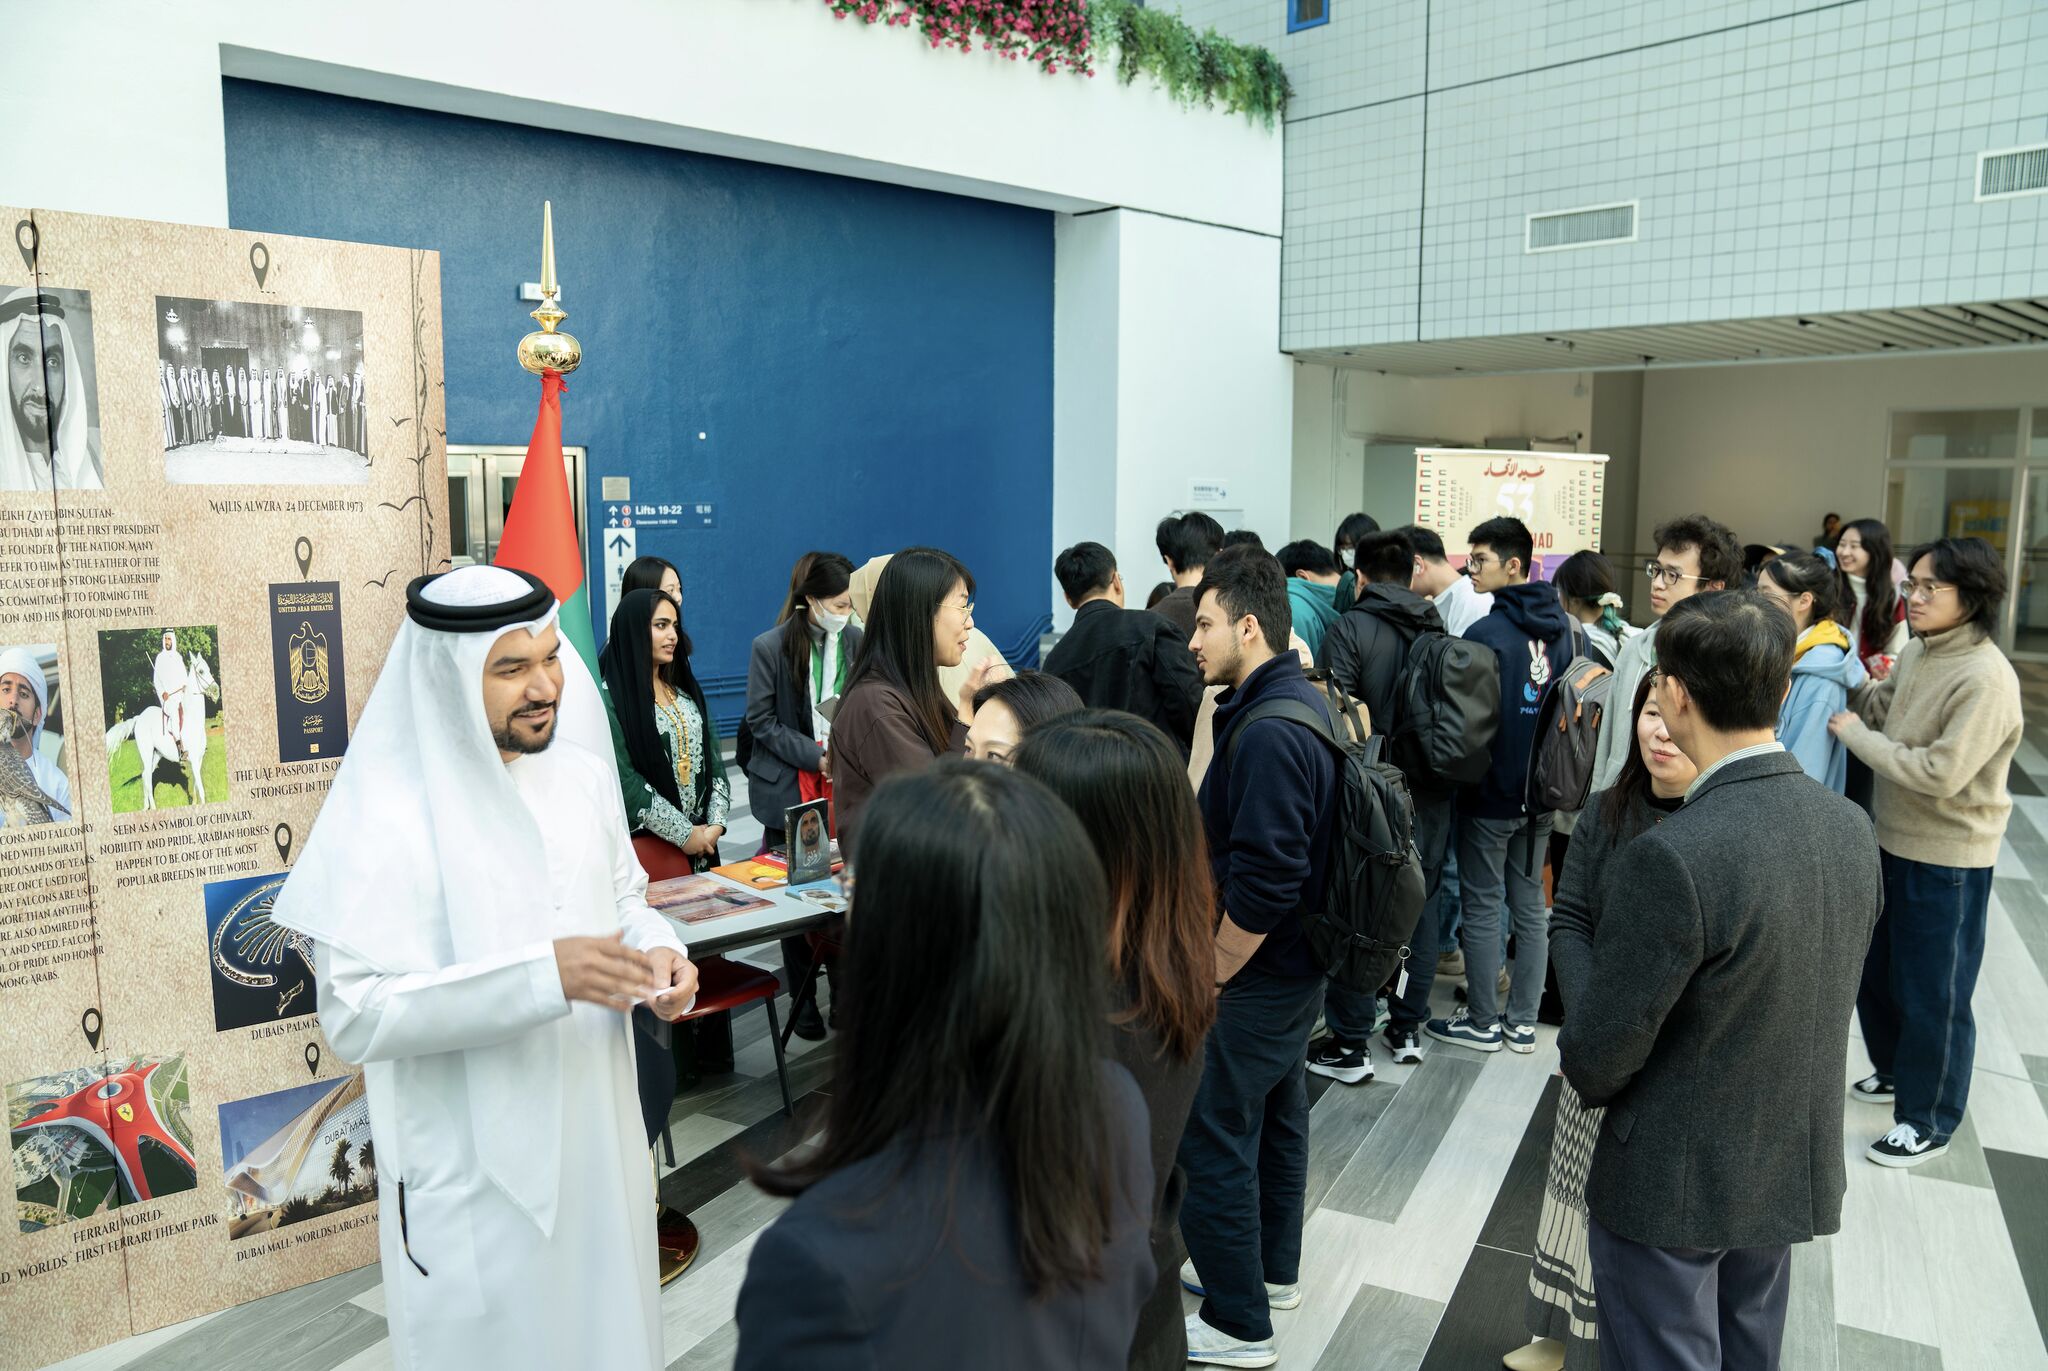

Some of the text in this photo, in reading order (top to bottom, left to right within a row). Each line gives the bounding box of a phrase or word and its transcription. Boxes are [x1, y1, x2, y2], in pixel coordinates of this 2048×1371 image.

[27, 510, 56, 523] ZAYED
[58, 509, 74, 518] BIN
[208, 500, 364, 514] MAJLIS ALWZRA 24 DECEMBER 1973
[635, 505, 682, 514] Lifts 19-22
[13, 528, 43, 537] DHABI
[46, 526, 65, 536] AND
[67, 525, 85, 536] THE
[87, 525, 110, 534] FIRST
[113, 524, 160, 534] PRESIDENT
[8, 544, 54, 555] FOUNDER
[56, 544, 68, 554] OF
[70, 542, 88, 553] THE
[90, 542, 127, 552] NATION.
[128, 540, 154, 553] MANY
[24, 562, 38, 572] TO
[40, 561, 58, 571] HIM
[60, 560, 71, 570] AS
[94, 558, 127, 568] FATHER
[130, 558, 142, 568] OF
[144, 558, 160, 567] THE
[38, 578, 50, 588] OF
[52, 576, 67, 588] HIS
[69, 575, 106, 586] STRONG
[108, 574, 160, 585] LEADERSHIP
[6, 592, 71, 606] COMMITMENT
[72, 592, 86, 602] TO
[88, 590, 130, 602] FORMING
[131, 590, 149, 600] THE
[22, 613, 42, 623] AND
[44, 612, 60, 622] HIS
[62, 608, 112, 620] PROFOUND
[114, 606, 156, 618] EMPATHY.
[234, 770, 253, 782] THE
[256, 768, 274, 780] UAE
[276, 763, 320, 777] PASSPORT
[321, 762, 329, 772] IS
[250, 782, 303, 799] STRONGEST
[306, 781, 316, 792] IN
[28, 830, 46, 842] AND
[49, 824, 94, 839] FALCONRY
[114, 824, 136, 836] SEEN
[138, 822, 150, 833] AS
[152, 822, 157, 832] A
[158, 818, 194, 830] SYMBOL
[196, 816, 208, 826] OF
[100, 825, 270, 856] NOBILITY AND PRIDE, ARABIAN HORSES
[22, 847, 45, 858] WITH
[48, 842, 82, 855] EMIRATI
[116, 843, 258, 871] HAPPEN TO BE ONE OF THE MOST
[55, 860, 66, 870] OF
[117, 860, 260, 888] POPULAR BREEDS IN THE WORLD.
[18, 878, 43, 890] ONCE
[45, 875, 68, 887] USED
[70, 872, 86, 884] FOR
[16, 893, 57, 907] FALCONS
[60, 890, 75, 900] ARE
[77, 885, 98, 898] USED
[26, 909, 50, 921] THAN
[52, 900, 98, 918] ANYTHING
[14, 928, 36, 940] ALSO
[39, 920, 79, 936] ADMIRED
[81, 916, 98, 928] FOR
[10, 944, 30, 956] AND
[32, 940, 60, 952] SPEED.
[62, 931, 100, 946] FALCONS
[9, 961, 23, 972] OF
[24, 956, 50, 969] PRIDE
[52, 953, 70, 964] AND
[72, 946, 104, 960] HONOR
[252, 1024, 285, 1040] DUBAIS
[286, 1020, 310, 1034] PALM
[324, 1126, 348, 1144] DUBAI
[73, 1220, 120, 1243] FERRARI
[76, 1244, 106, 1263] FIRST
[108, 1230, 152, 1251] FERRARI
[154, 1220, 190, 1240] THEME
[192, 1213, 218, 1230] PARK
[236, 1246, 266, 1262] DUBAI
[295, 1228, 332, 1246] WORLDS
[334, 1215, 370, 1234] LARGEST
